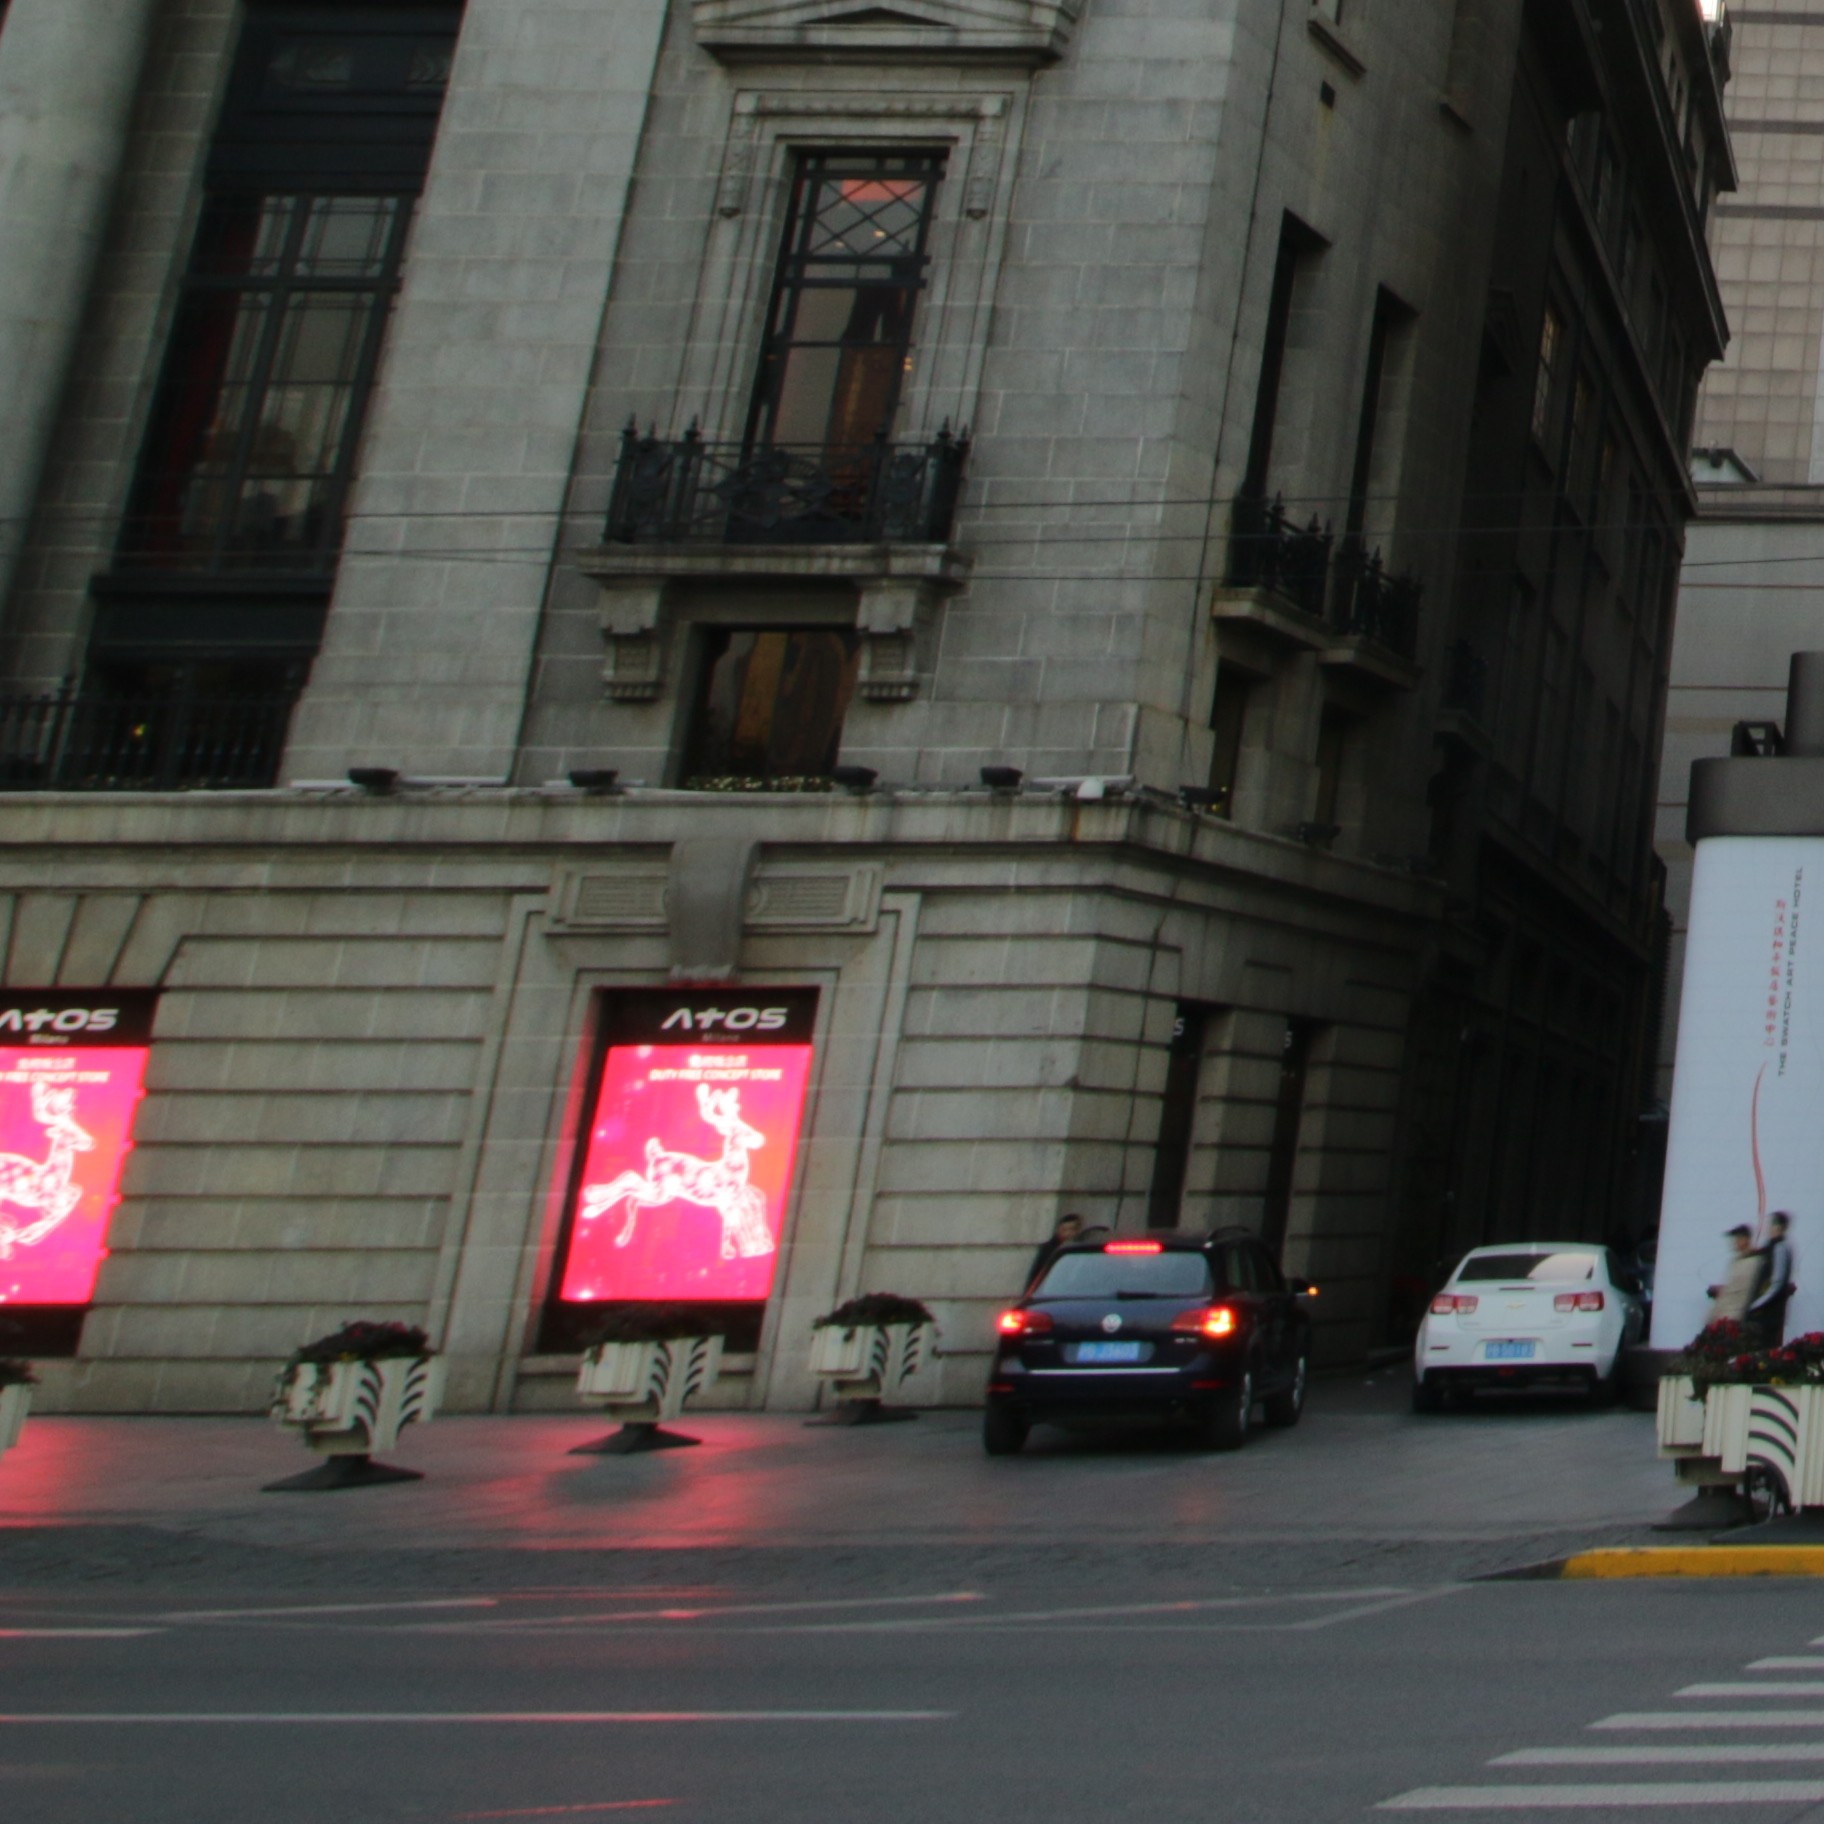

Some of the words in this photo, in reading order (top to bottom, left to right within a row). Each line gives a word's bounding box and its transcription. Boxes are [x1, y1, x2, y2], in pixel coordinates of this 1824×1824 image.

[1793, 866, 1803, 908] HOTEL
[1788, 912, 1799, 956] PEACE
[1786, 959, 1795, 987] ART
[661, 1007, 789, 1030] ATOS
[1781, 990, 1793, 1047] SWATCH
[1778, 1052, 1788, 1077] THE
